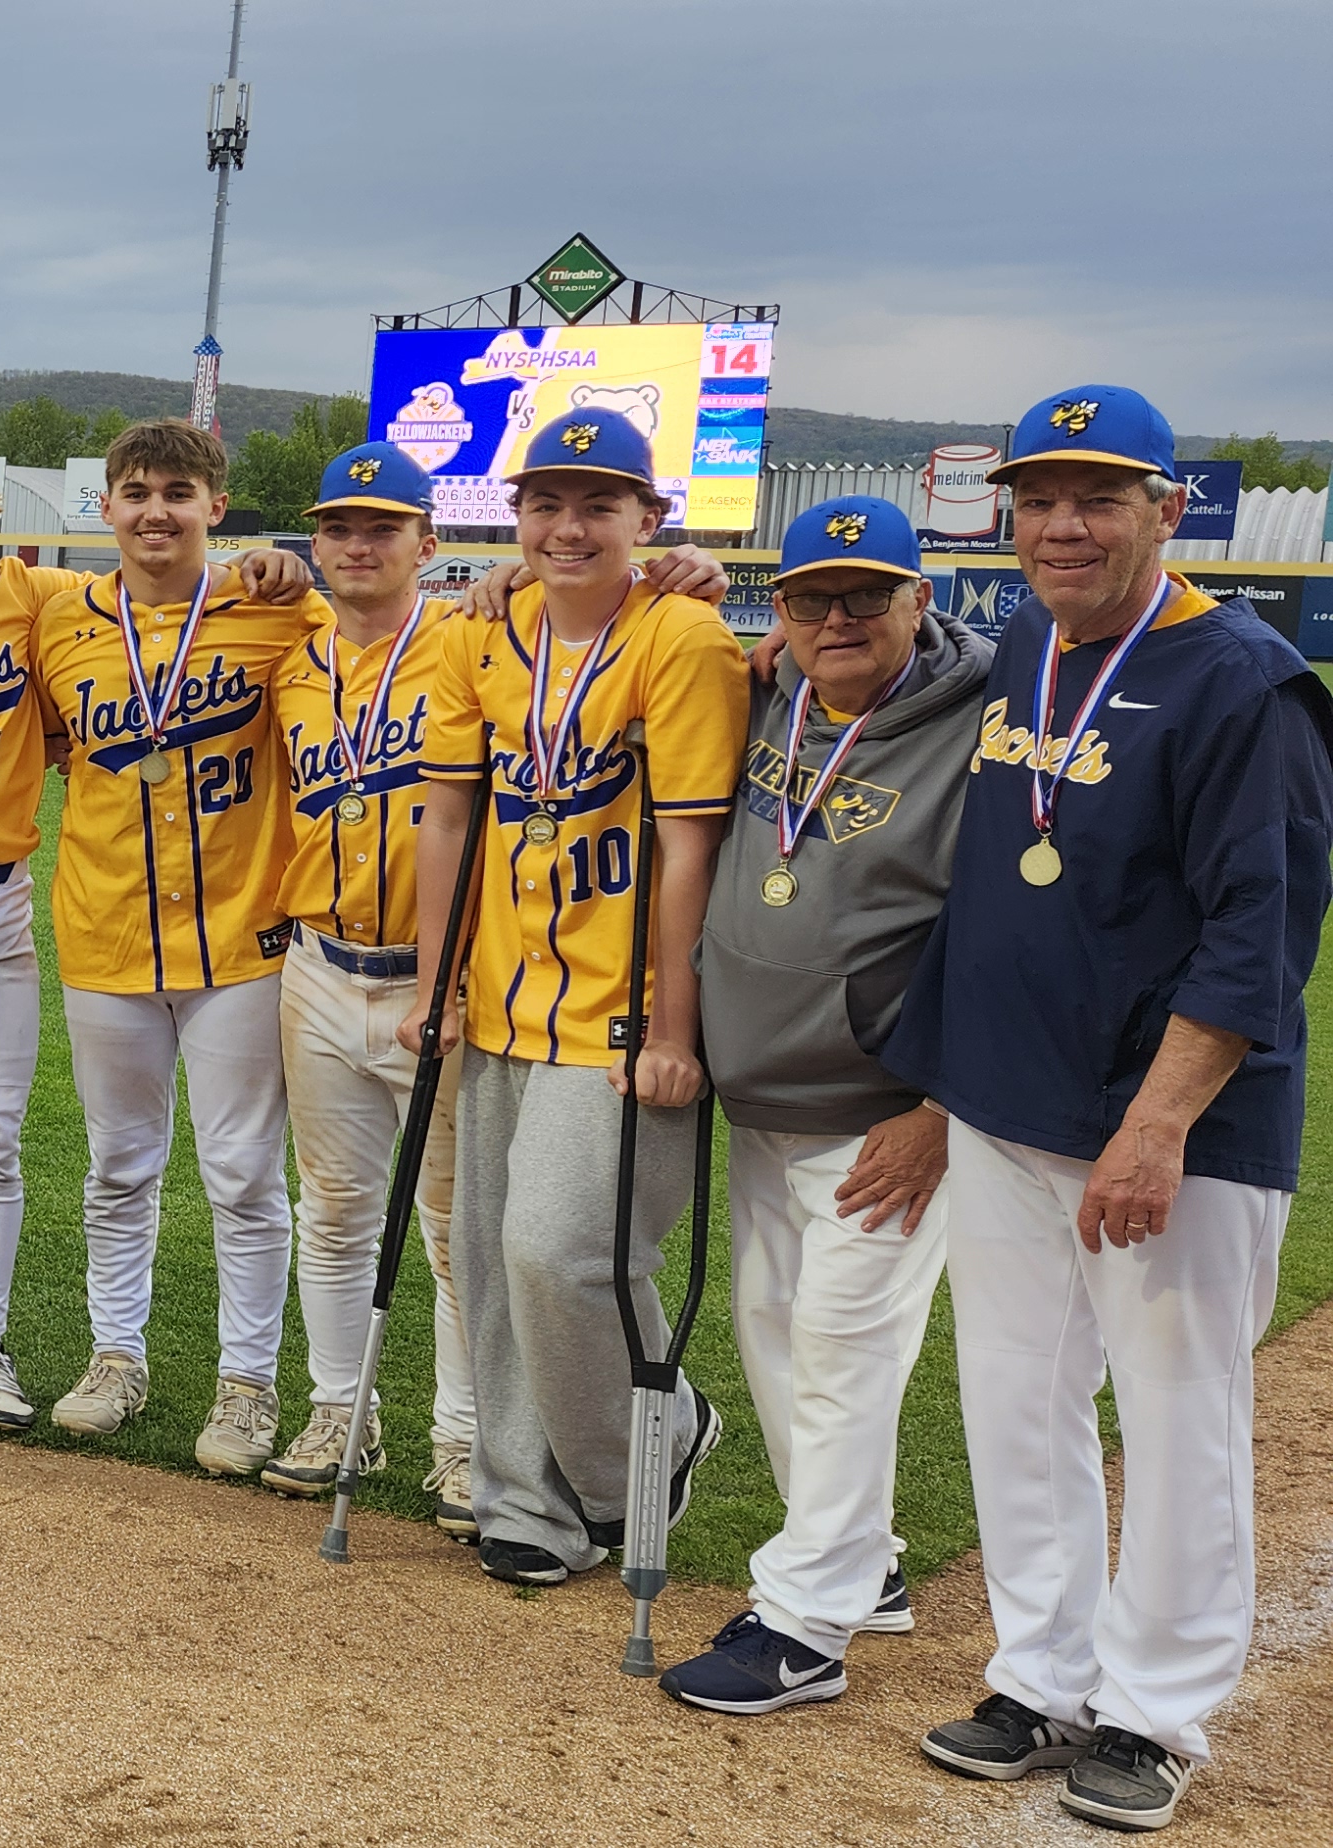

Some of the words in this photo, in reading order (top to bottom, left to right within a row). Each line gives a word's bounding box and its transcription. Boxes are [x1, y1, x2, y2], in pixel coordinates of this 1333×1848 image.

[486, 351, 596, 368] NYSPHSAA
[711, 344, 757, 374] 14
[387, 423, 472, 440] YELLOWJACKETS
[698, 438, 737, 452] NBT
[707, 450, 758, 464] BANK
[934, 470, 987, 486] meldrim'
[450, 490, 458, 500] 6
[463, 490, 472, 500] 3
[490, 490, 499, 500] 2
[448, 508, 457, 518] 4
[475, 508, 484, 518] 2
[1183, 504, 1222, 515] Kattell
[207, 539, 239, 550] 375
[932, 540, 968, 548] Benjamin
[971, 541, 997, 549] Moore
[418, 578, 473, 594] ugust
[1237, 586, 1285, 600] Nissan
[724, 590, 746, 605] cal
[751, 591, 774, 606] 32
[723, 612, 772, 626] 9-6171
[287, 694, 429, 793] Jacet
[567, 825, 634, 904] 10
